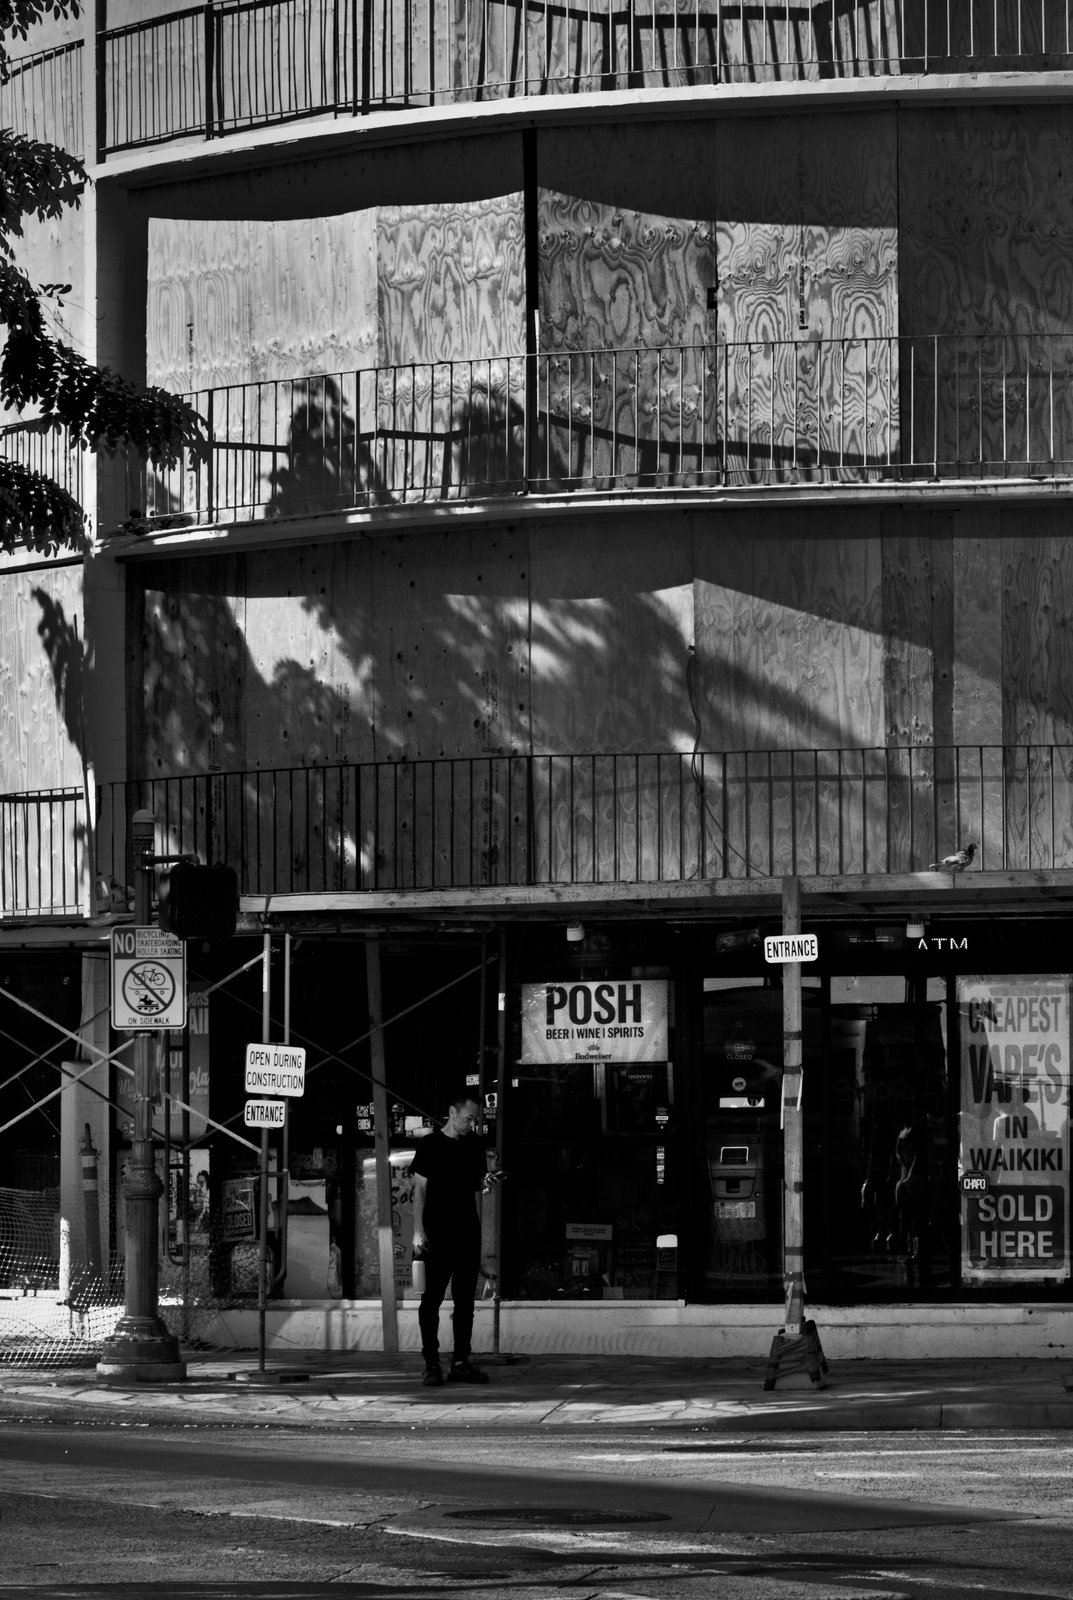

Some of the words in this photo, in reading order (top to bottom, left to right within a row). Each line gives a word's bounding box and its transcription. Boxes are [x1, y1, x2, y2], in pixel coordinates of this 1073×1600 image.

[114, 932, 135, 954] NO
[137, 939, 181, 947] SKATEBOARDING
[137, 948, 158, 956] ROLLER
[160, 948, 182, 956] SKATING
[767, 939, 816, 958] ENTRANCE
[917, 937, 968, 951] ATM
[546, 983, 641, 1026] POSH
[128, 1017, 137, 1025] ON
[140, 1017, 170, 1025] SIDEWALK
[969, 996, 1062, 1033] CHEAPEST
[546, 1028, 569, 1040] BEER
[576, 1027, 601, 1039] WINE
[607, 1026, 644, 1039] SPIRITS
[249, 1050, 271, 1066] OPEN
[273, 1053, 302, 1069] DURING
[575, 1051, 612, 1060] Budweiser
[246, 1072, 303, 1089] CONSTRUCTION
[969, 1043, 1063, 1104] VAPE'S
[246, 1105, 284, 1122] ENTRANCE
[1005, 1115, 1028, 1139] IN
[970, 1148, 1063, 1171] WAIKIKI
[977, 1194, 1054, 1222] SOLD
[979, 1230, 1054, 1258] HERE
